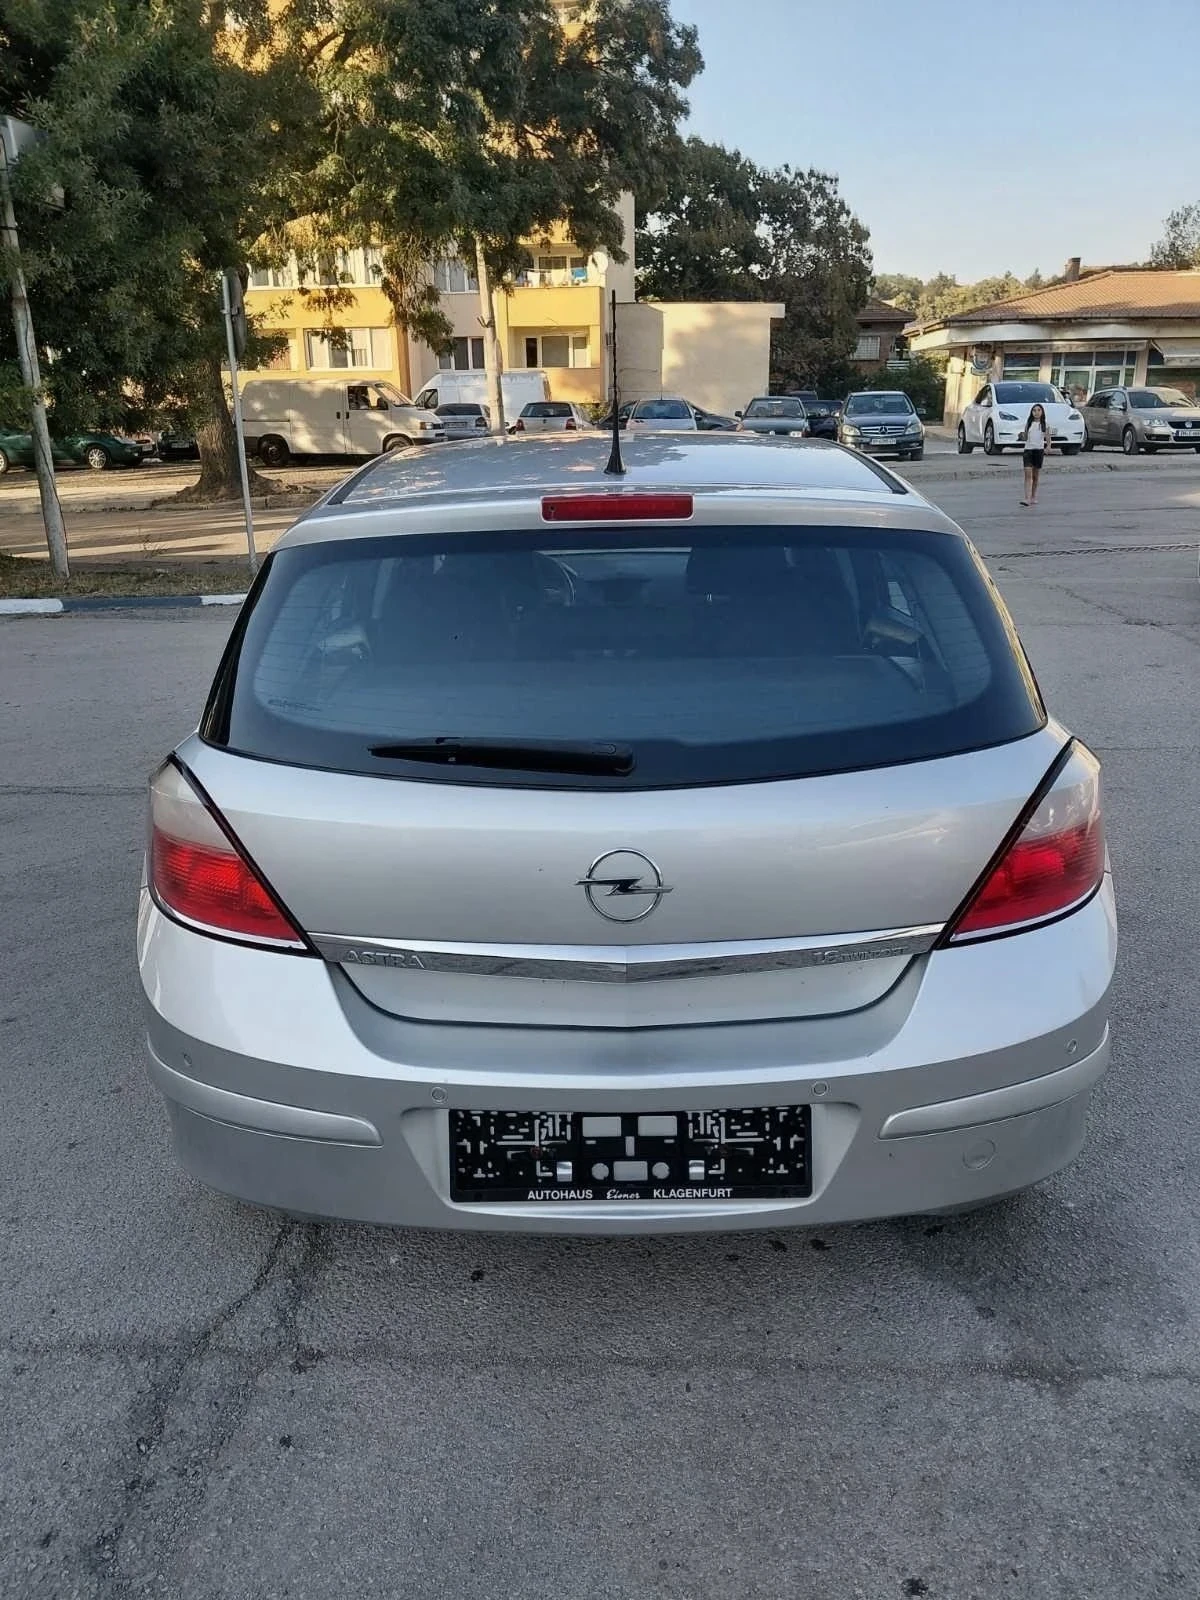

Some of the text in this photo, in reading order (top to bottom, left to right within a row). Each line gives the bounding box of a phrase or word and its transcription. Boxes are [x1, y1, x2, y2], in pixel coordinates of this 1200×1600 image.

[347, 950, 425, 969] ASTRA
[527, 1190, 593, 1200] AUTOHAUS
[653, 1188, 733, 1199] KLAGENFURT
